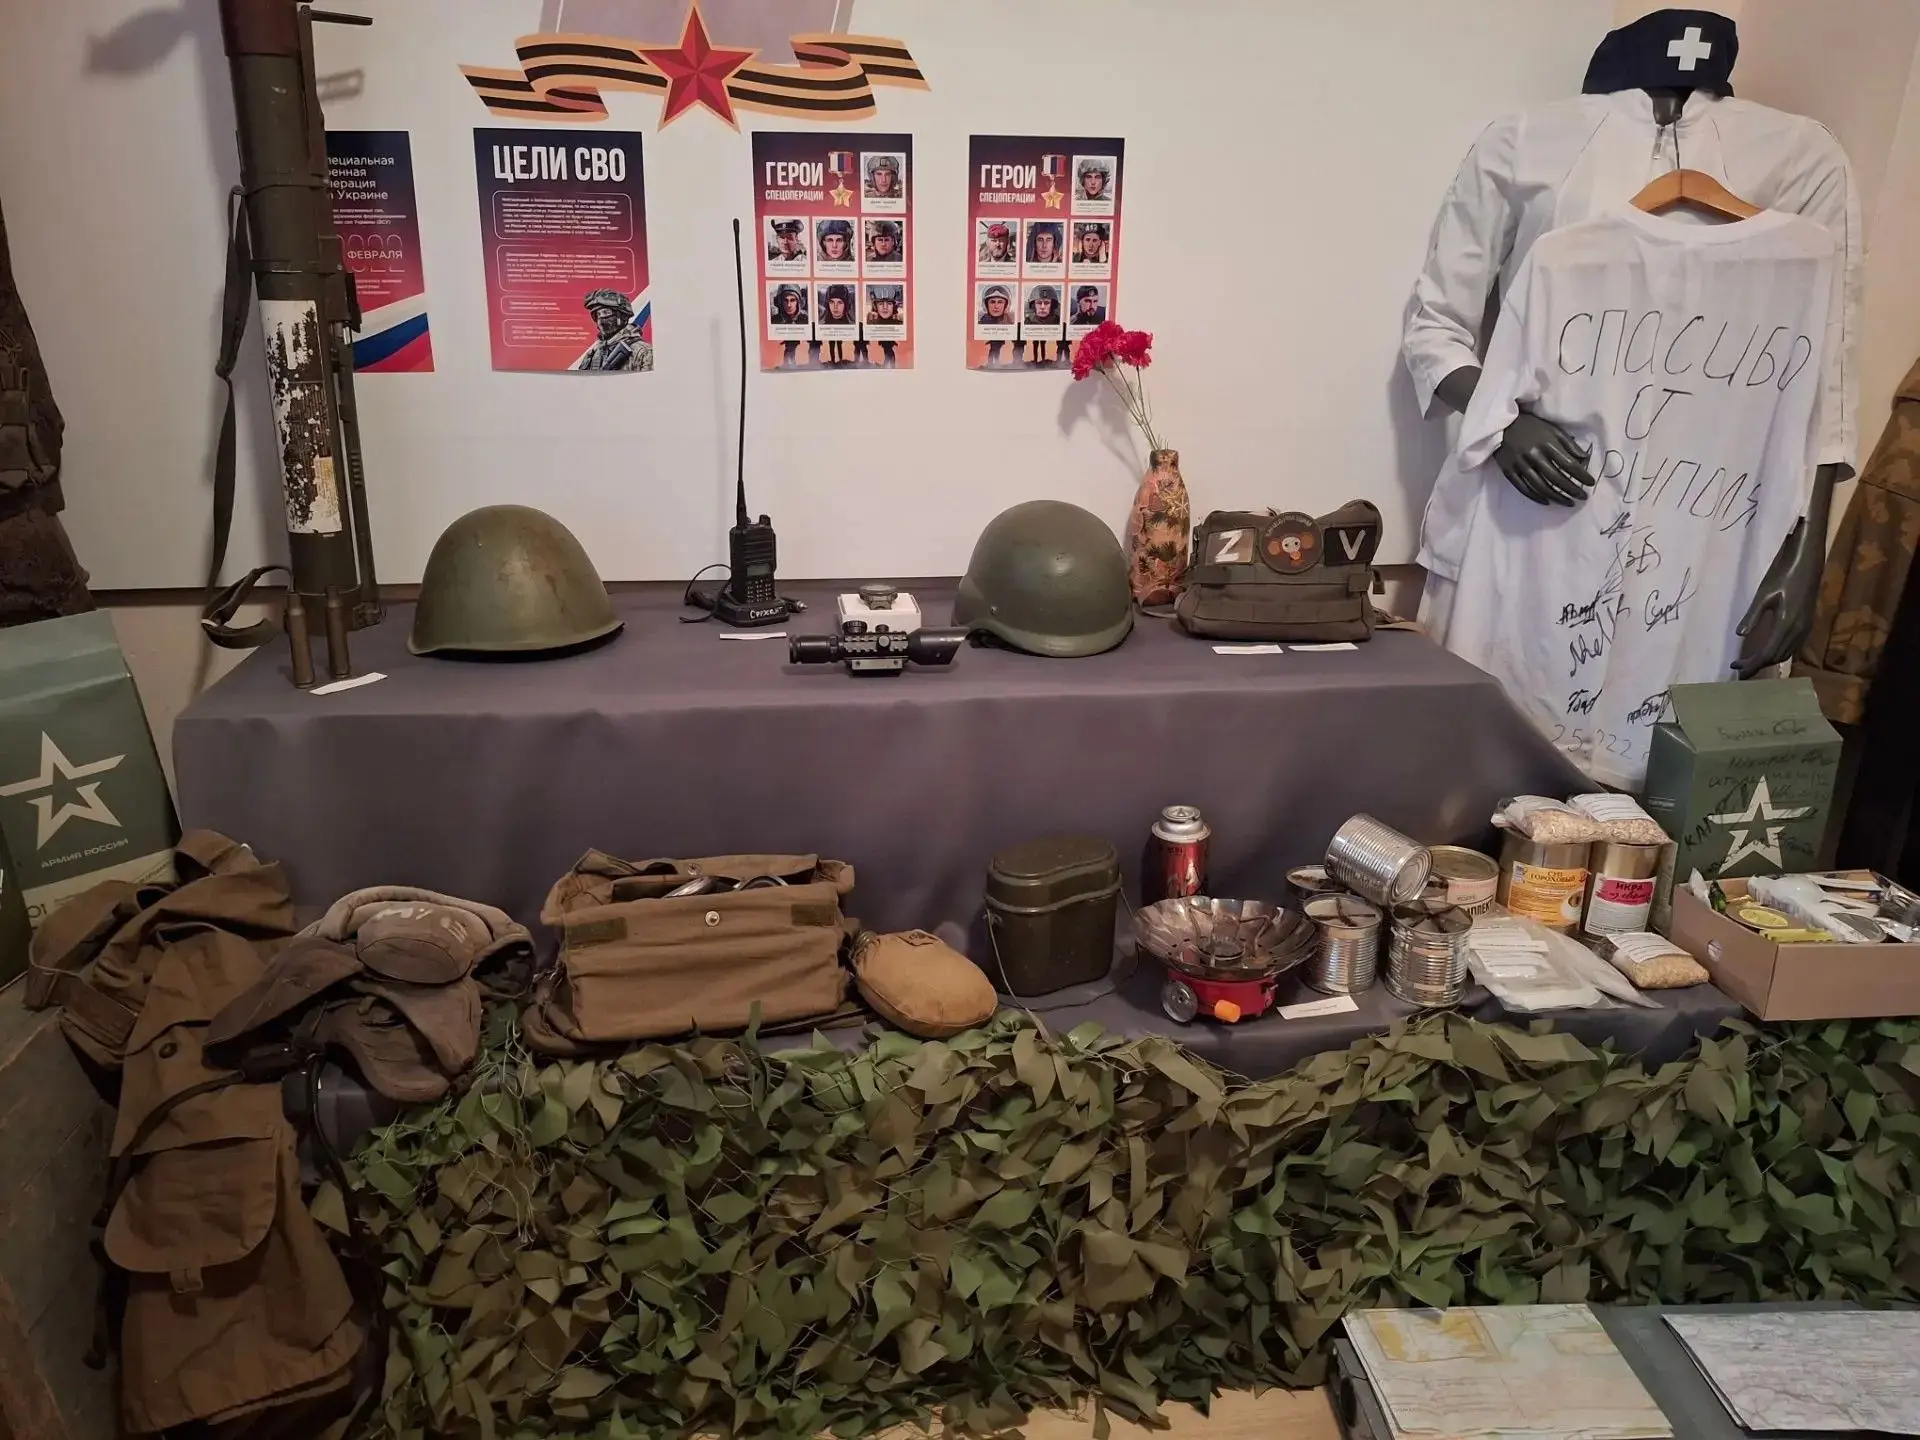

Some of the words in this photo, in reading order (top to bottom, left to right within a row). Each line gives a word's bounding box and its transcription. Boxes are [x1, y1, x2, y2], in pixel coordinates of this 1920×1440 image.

[328, 156, 395, 167] пециальная
[492, 145, 568, 183] ЦЕЛИ
[574, 147, 626, 182] СВО
[328, 169, 367, 177] енная
[765, 161, 824, 187] ГЕРОИ
[980, 164, 1036, 189] ГЕРОИ
[330, 180, 377, 190] ерация
[338, 190, 388, 200] Украине
[765, 190, 824, 202] СПЕЦОПЕРАЦИИ
[979, 191, 1036, 204] СПЕЦОПЕРАЦИИ
[347, 250, 403, 259] ФЕВРАЛЯ
[1558, 309, 1812, 392] СПАСИБО
[1215, 529, 1242, 563] Z
[1338, 529, 1366, 560] V
[41, 852, 82, 868] АРМИЯ
[84, 838, 129, 856] РОССИИ
[1530, 873, 1576, 883] ГОРОХОВЫЙ
[1615, 882, 1643, 891] ИКРА
